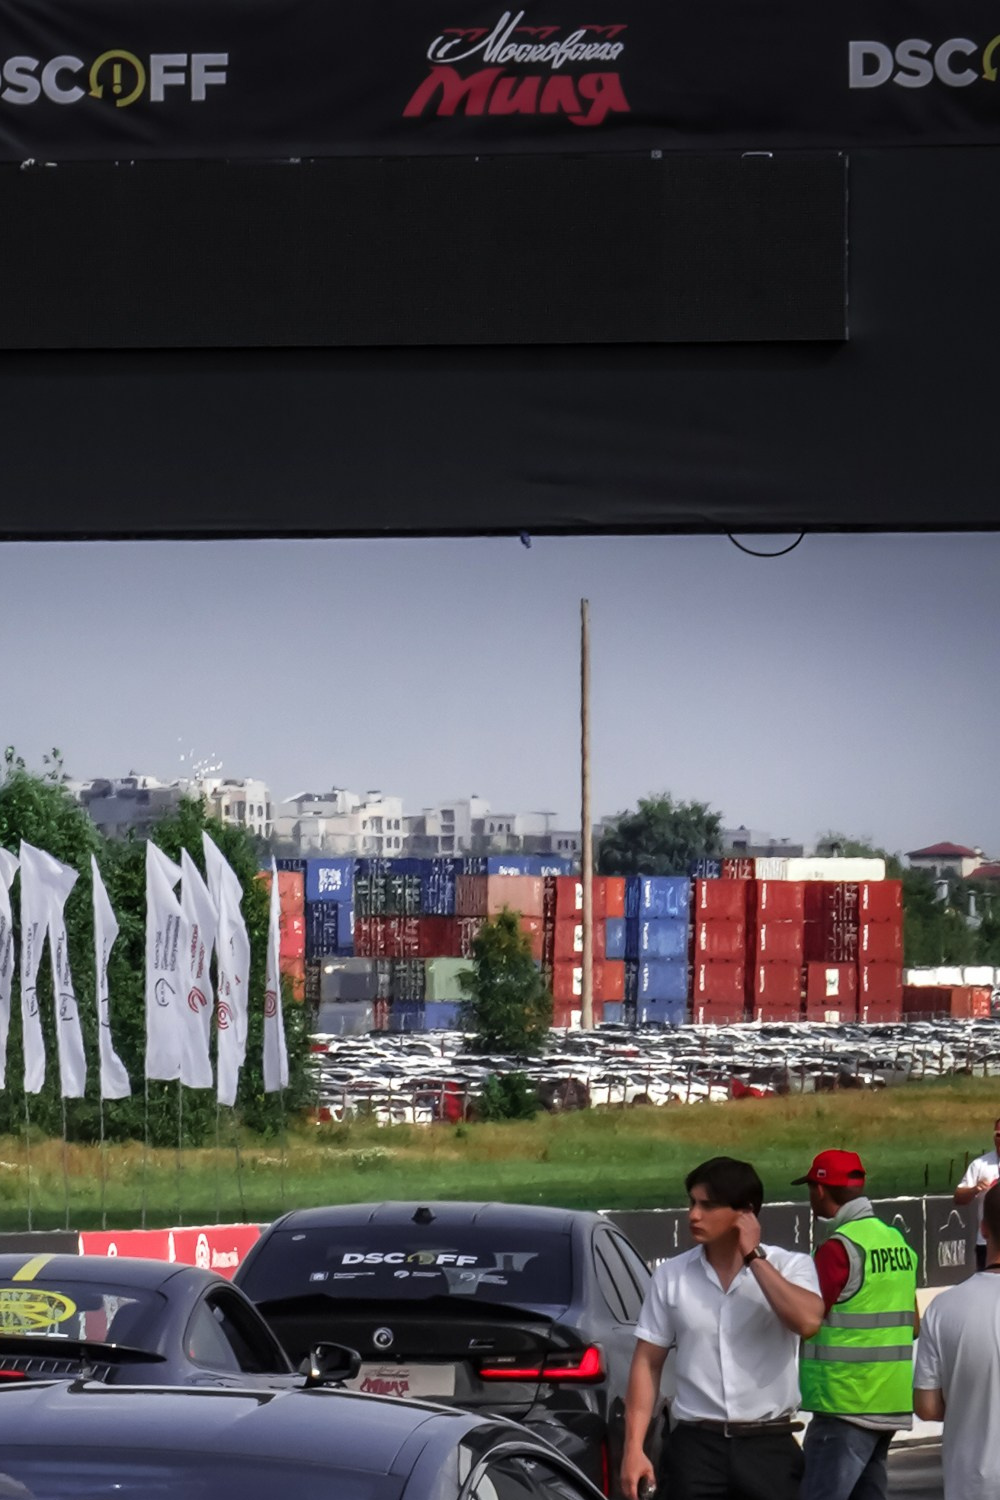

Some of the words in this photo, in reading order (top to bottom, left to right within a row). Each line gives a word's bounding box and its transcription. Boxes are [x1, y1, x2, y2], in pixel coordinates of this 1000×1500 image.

[427, 11, 624, 69] Московская
[402, 66, 630, 126] Миля
[870, 1247, 913, 1273] ПРЕССА
